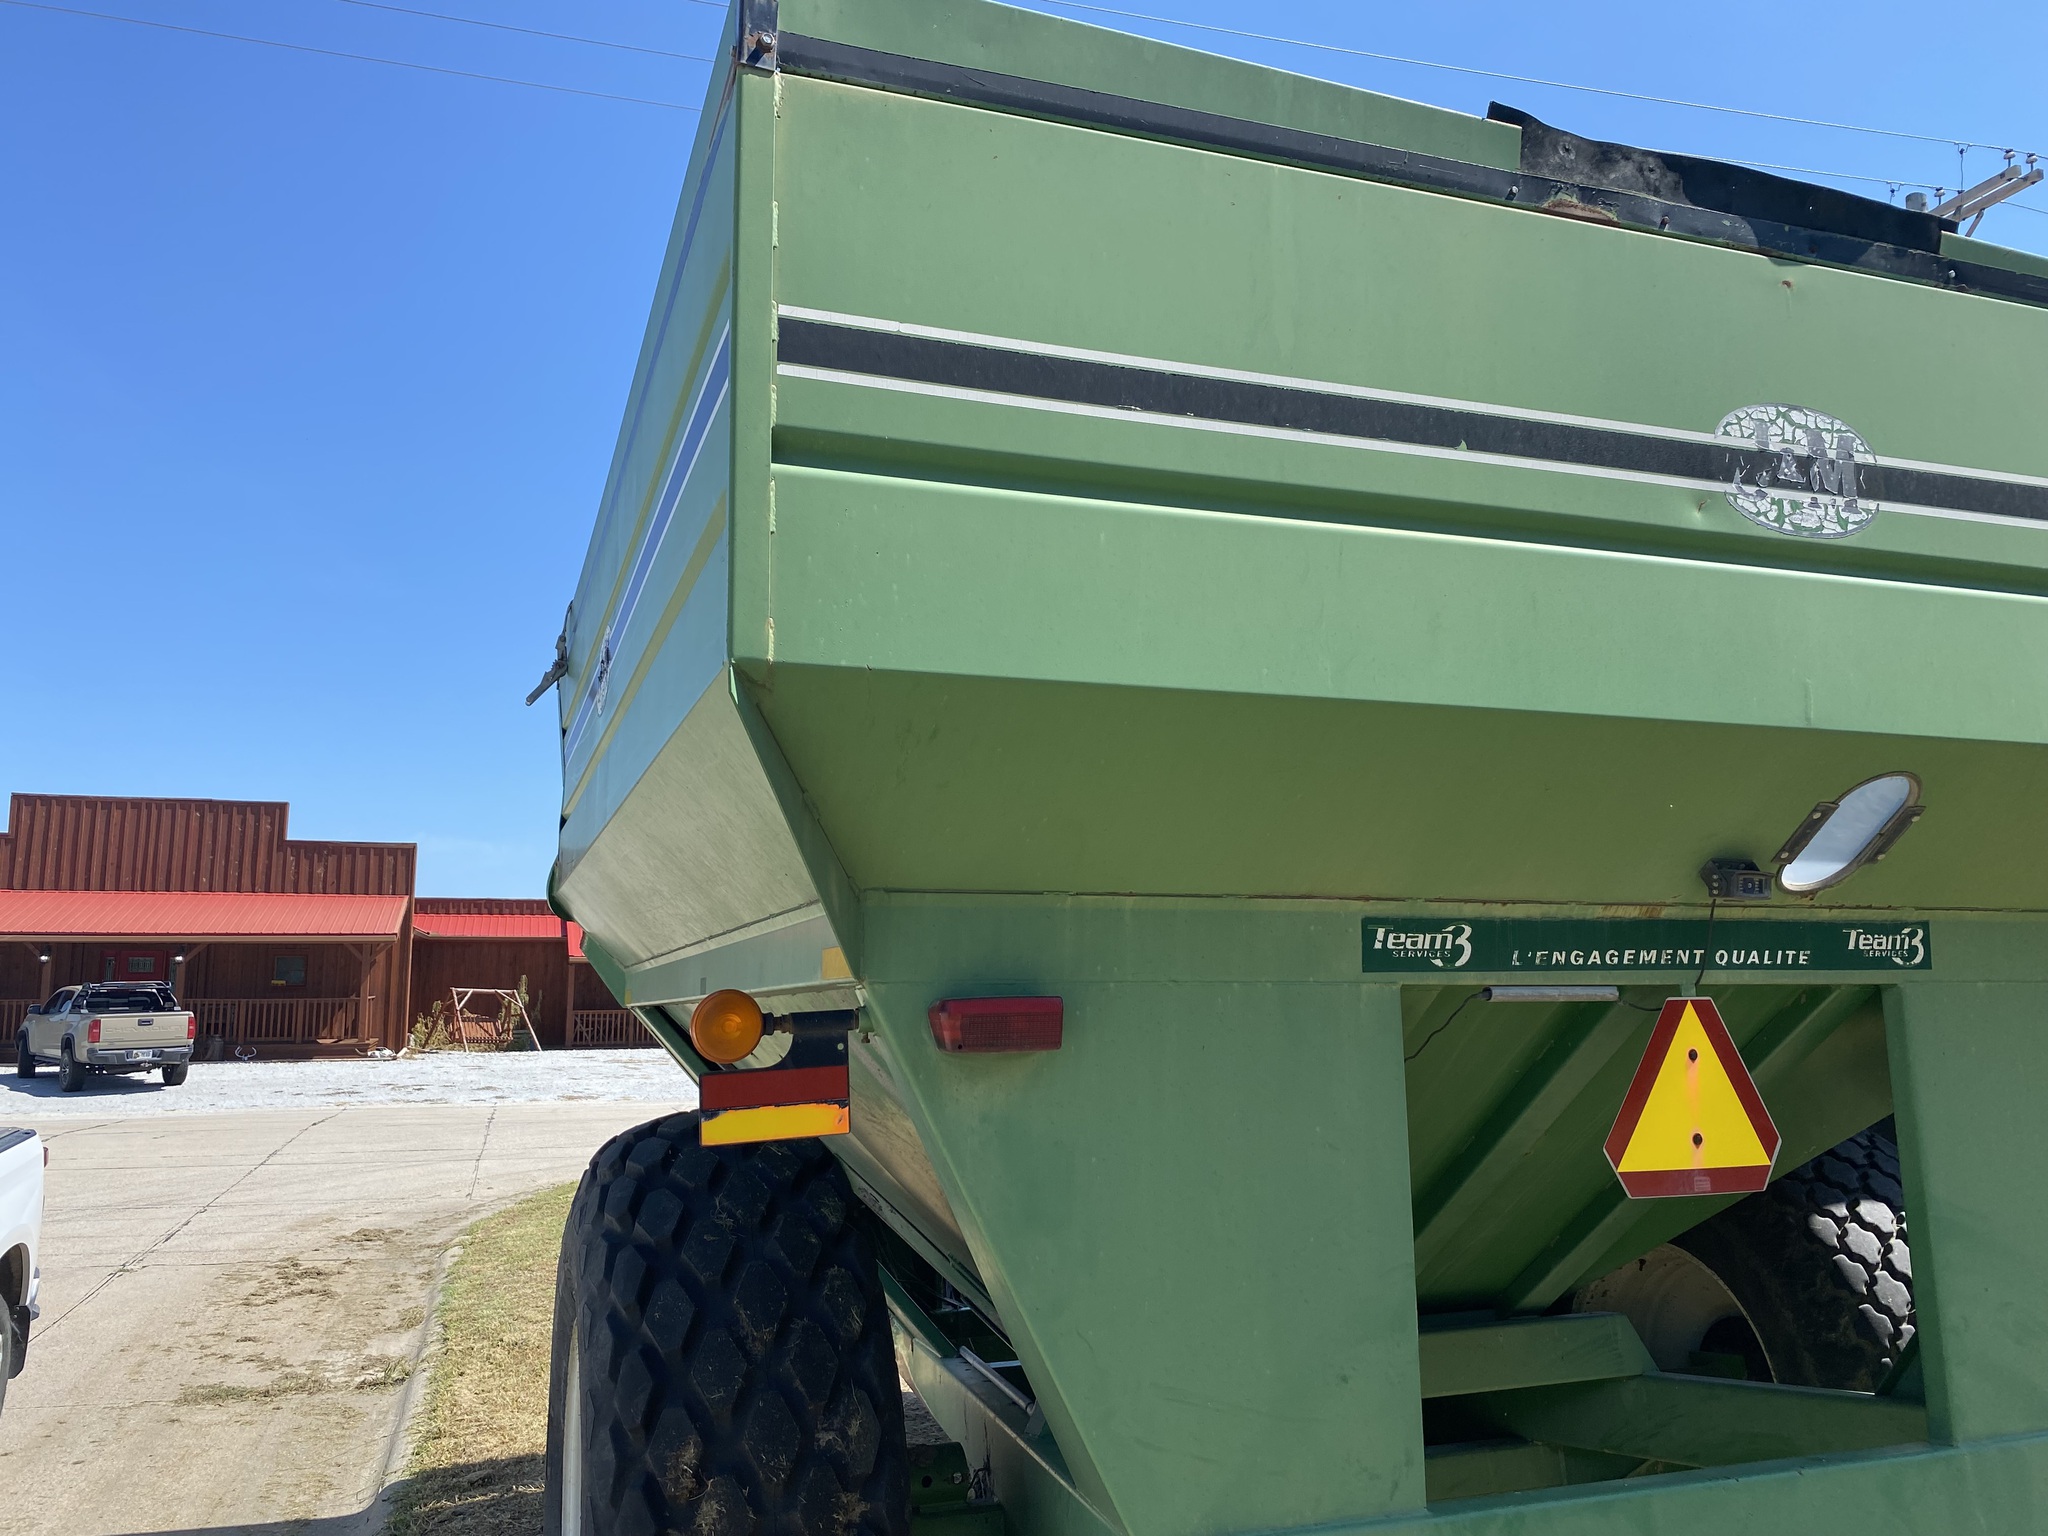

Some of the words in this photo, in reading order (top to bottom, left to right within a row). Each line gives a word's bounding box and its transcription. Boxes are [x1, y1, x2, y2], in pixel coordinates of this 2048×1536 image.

[1391, 949, 1451, 958] SERVICES
[1715, 949, 1811, 966] QUALITE
[1863, 949, 1909, 957] SERVICES
[105, 1024, 184, 1034] CHEVROLET
